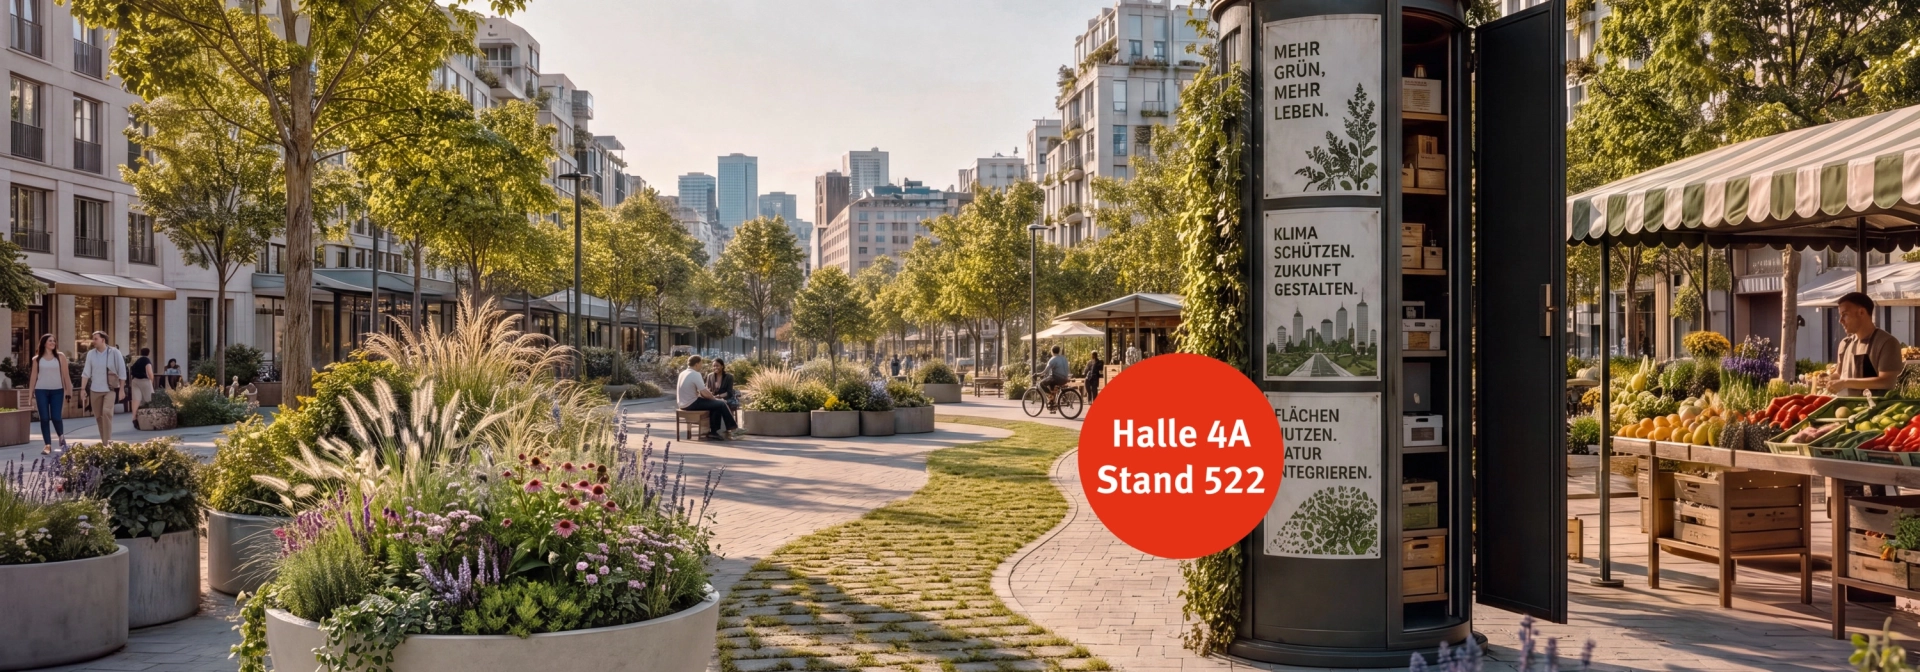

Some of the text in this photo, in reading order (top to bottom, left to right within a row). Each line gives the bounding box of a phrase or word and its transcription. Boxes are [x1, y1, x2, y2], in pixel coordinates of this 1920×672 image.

[1274, 41, 1320, 60] MEHR
[1274, 59, 1326, 80] GRÜN,
[1274, 82, 1321, 101] MEHR
[1274, 102, 1329, 121] LEBEN.
[1274, 226, 1318, 241] KLIMA
[1274, 242, 1355, 259] SCHÜTZEN.
[1274, 263, 1341, 278] ZUKUNFT
[1274, 282, 1358, 297] GESTALTEN.
[1274, 405, 1340, 423] FLÄCHEN
[1284, 446, 1322, 461] ATUR
